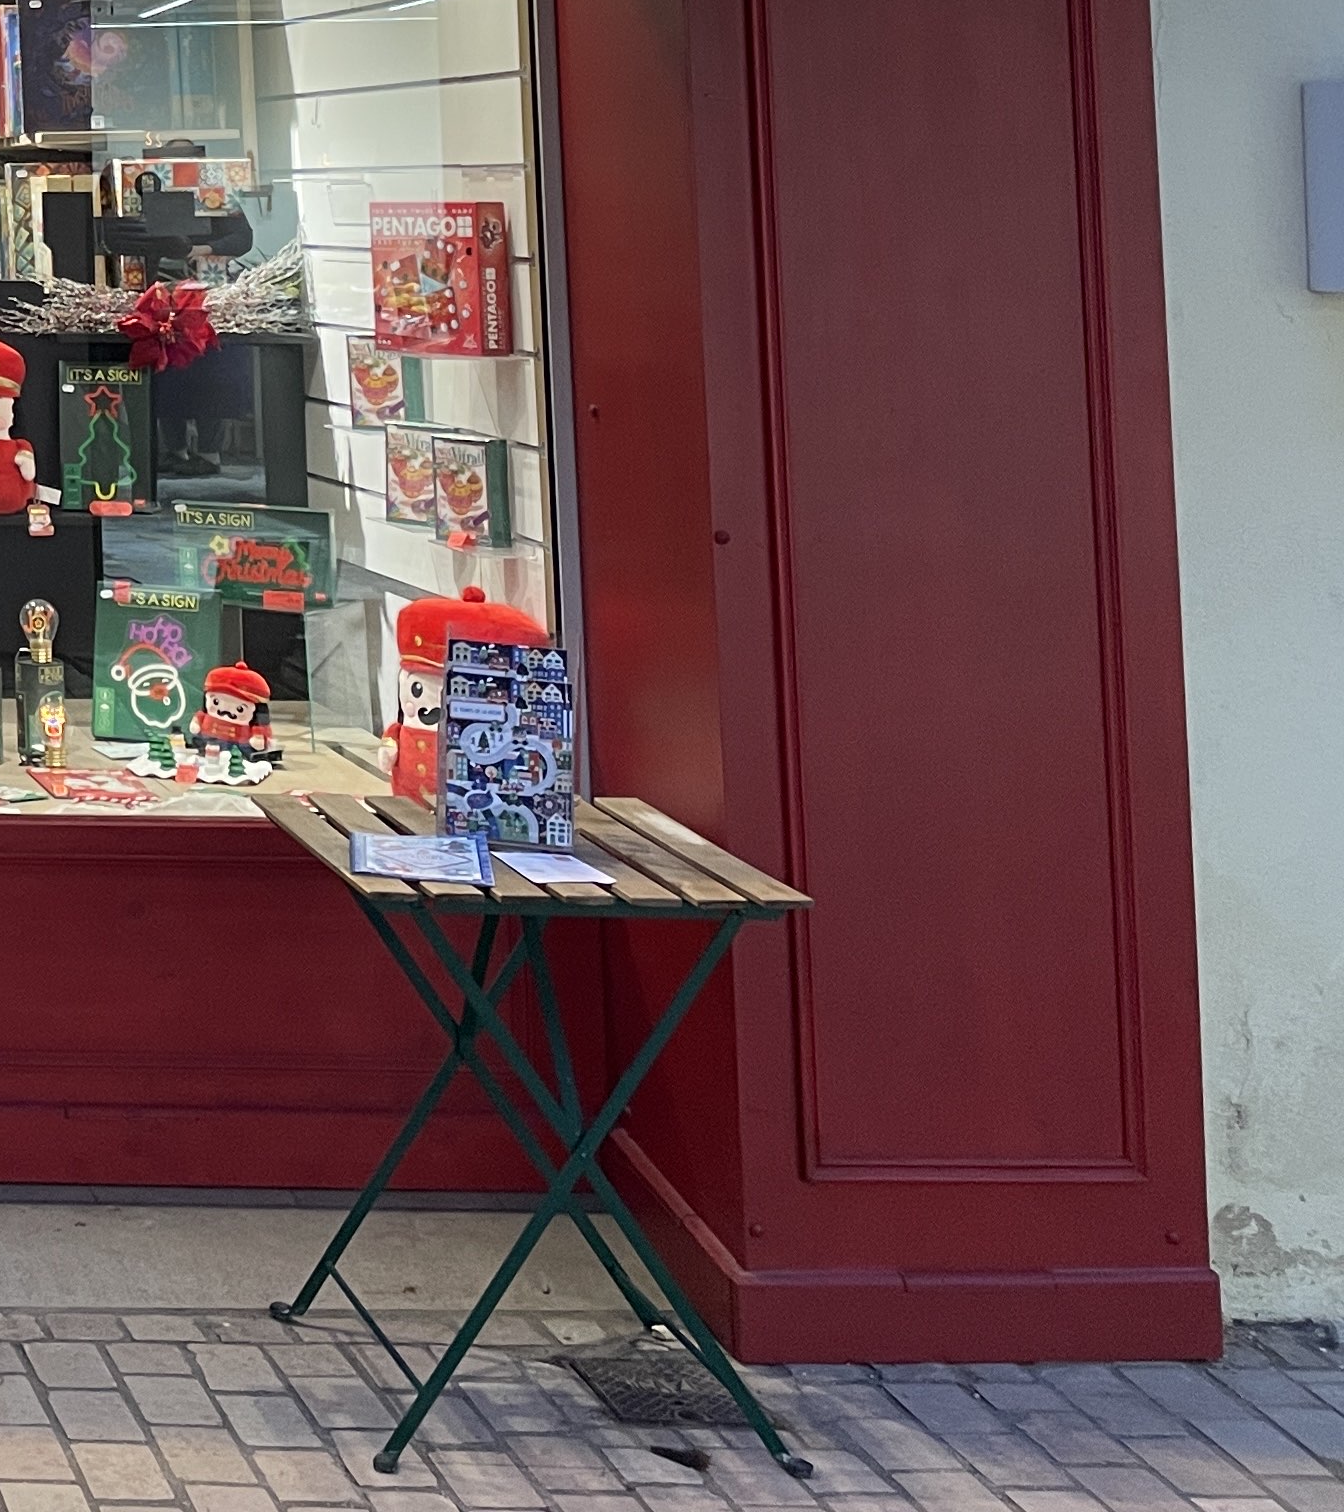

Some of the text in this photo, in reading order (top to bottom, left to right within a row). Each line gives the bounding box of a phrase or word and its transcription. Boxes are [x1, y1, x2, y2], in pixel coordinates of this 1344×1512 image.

[372, 216, 456, 237] PENTAGO
[486, 280, 499, 349] PENTAGO
[69, 368, 140, 382] IT'S A SIGN
[205, 513, 217, 525] A
[218, 514, 251, 527] SIGN
[147, 593, 160, 606] A
[161, 594, 197, 609] SIGN
